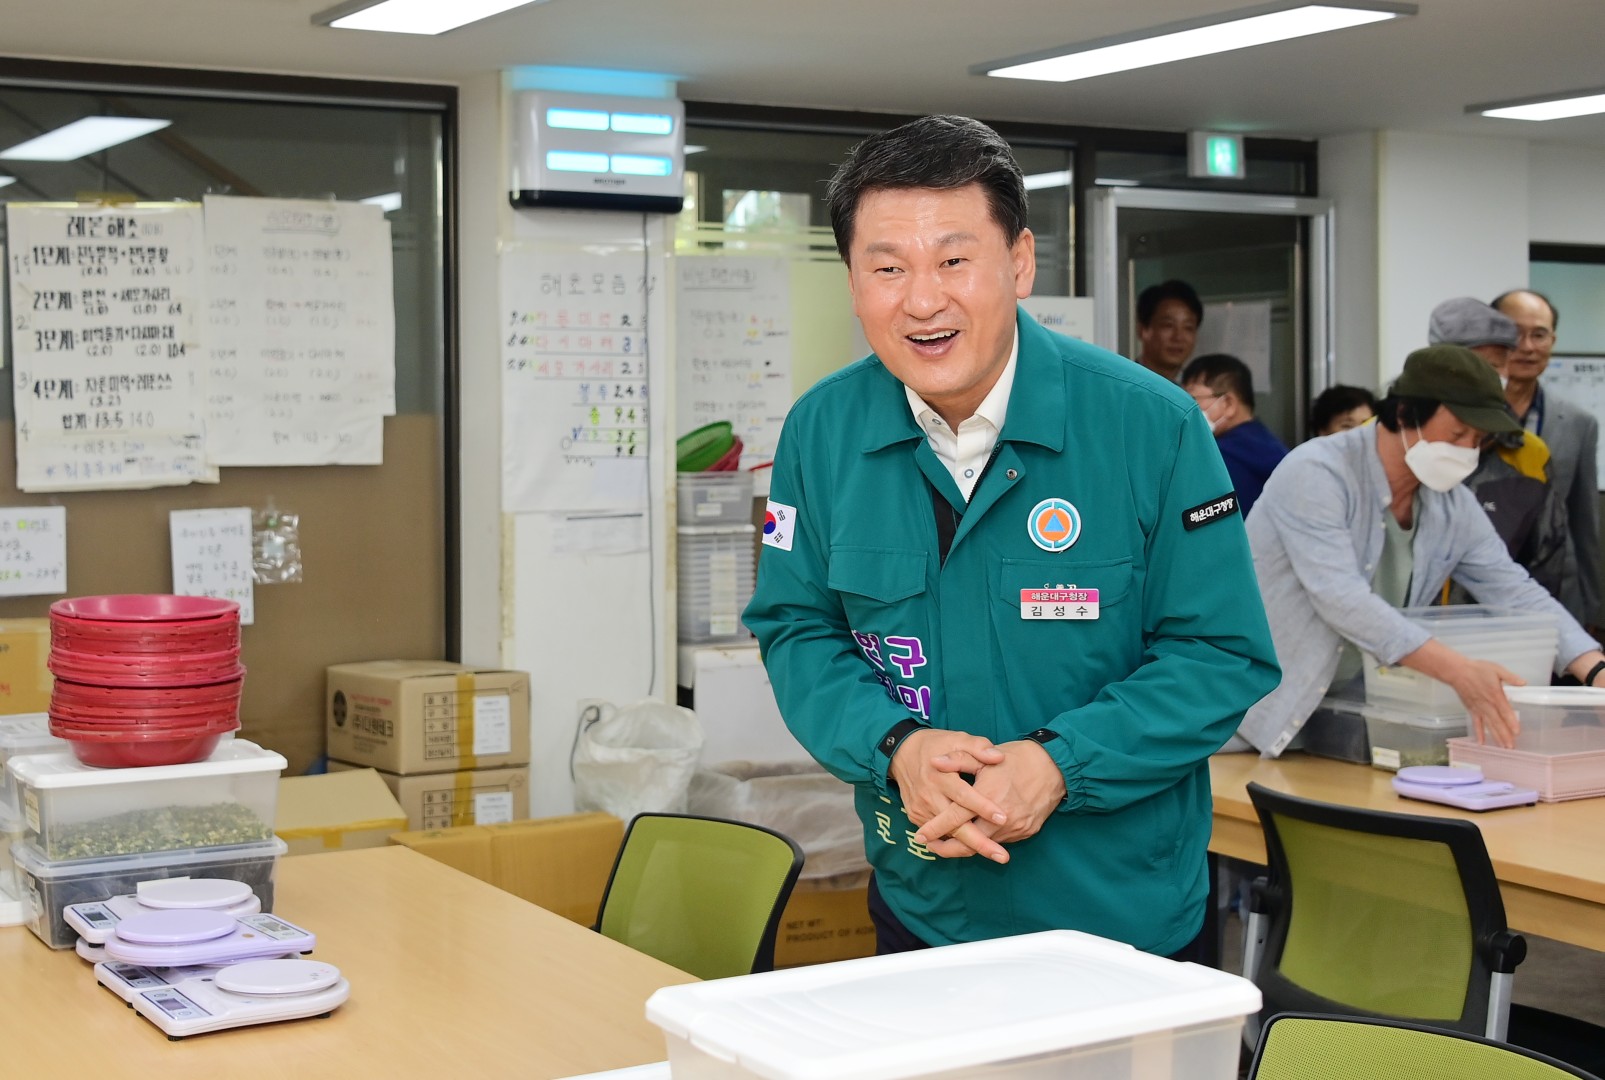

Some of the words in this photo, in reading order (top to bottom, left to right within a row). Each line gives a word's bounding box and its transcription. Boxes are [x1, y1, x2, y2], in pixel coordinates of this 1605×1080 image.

[107, 216, 140, 239] 해초
[1189, 497, 1234, 523] 해운대구청장
[1031, 591, 1088, 602] 해운대구청장
[1031, 605, 1089, 617] 김성수
